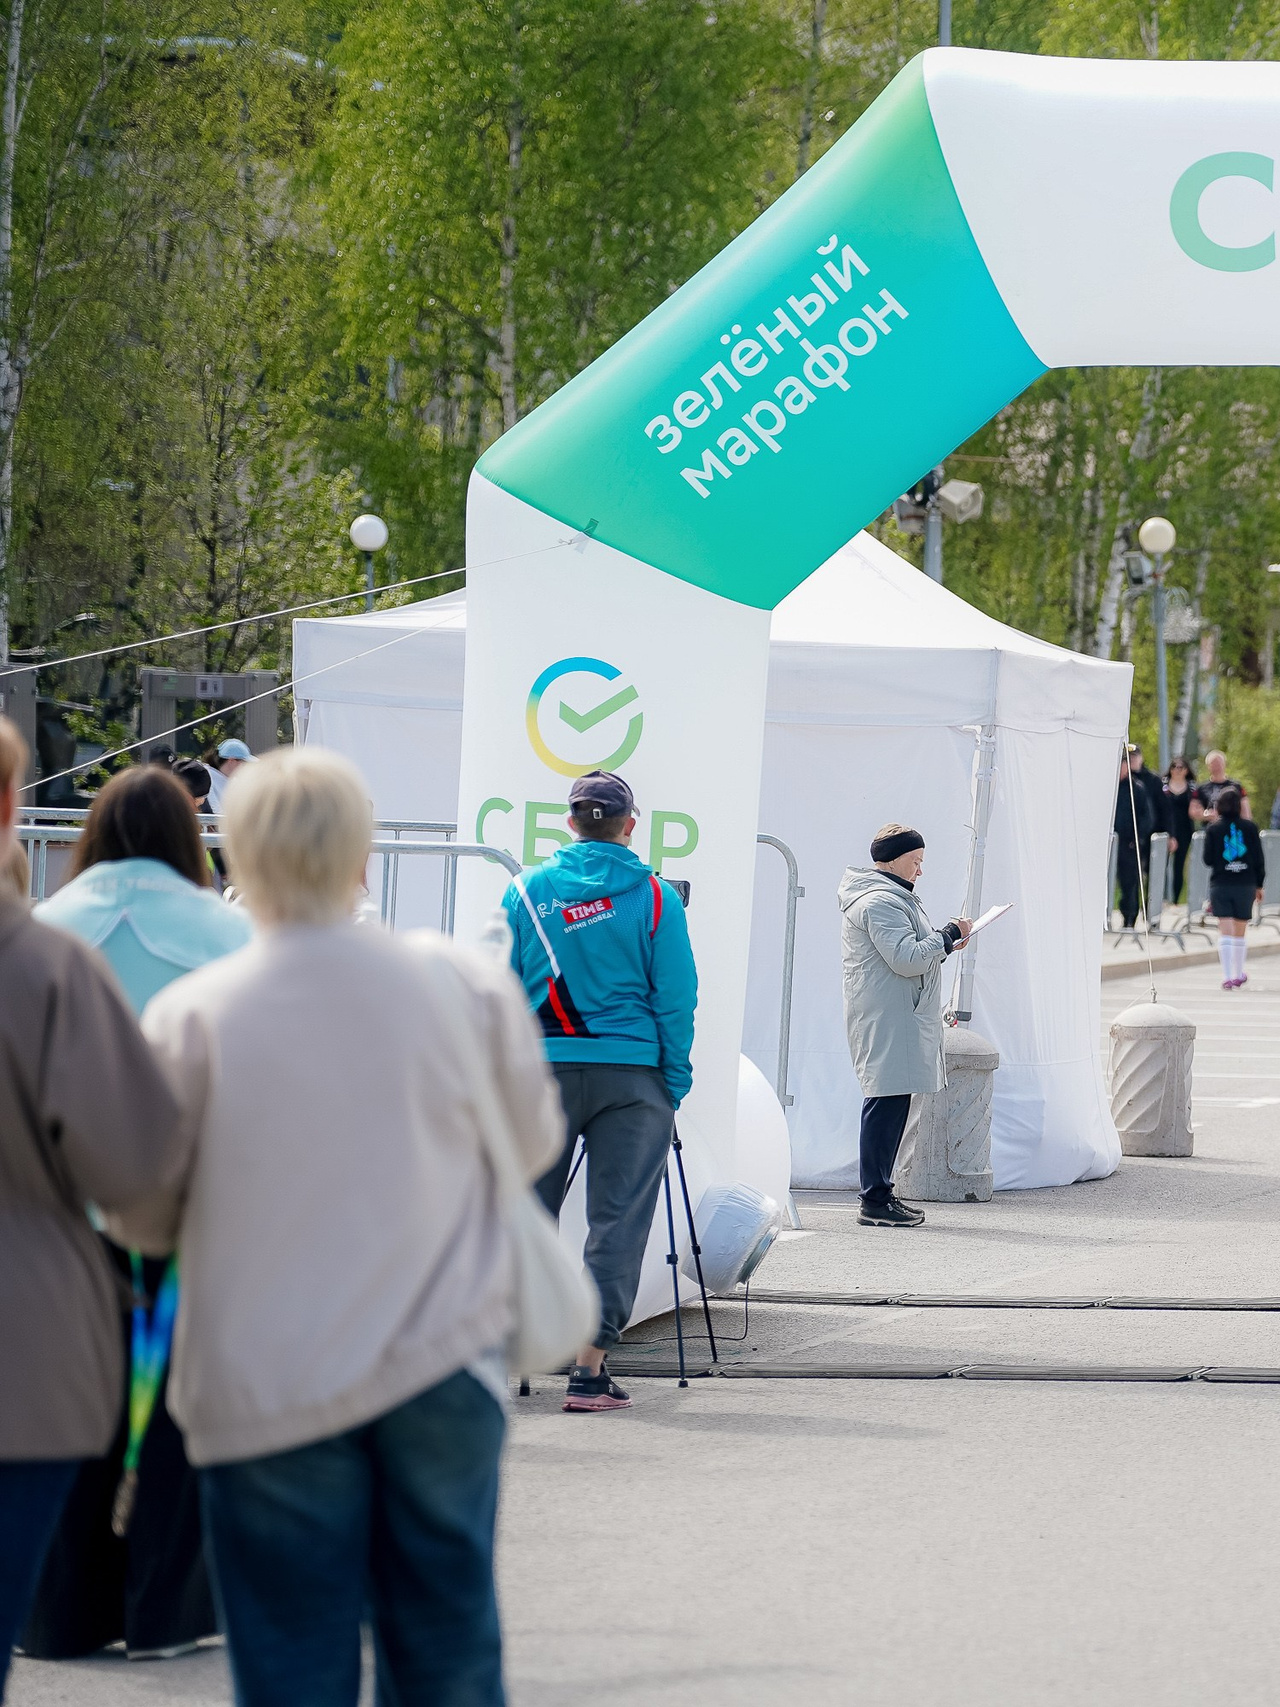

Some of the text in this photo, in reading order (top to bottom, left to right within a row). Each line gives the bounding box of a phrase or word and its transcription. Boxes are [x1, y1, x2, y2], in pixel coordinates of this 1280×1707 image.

[643, 233, 871, 454] зелёный
[679, 287, 910, 500] марафон
[475, 797, 699, 876] СБР
[567, 899, 606, 920] TIME
